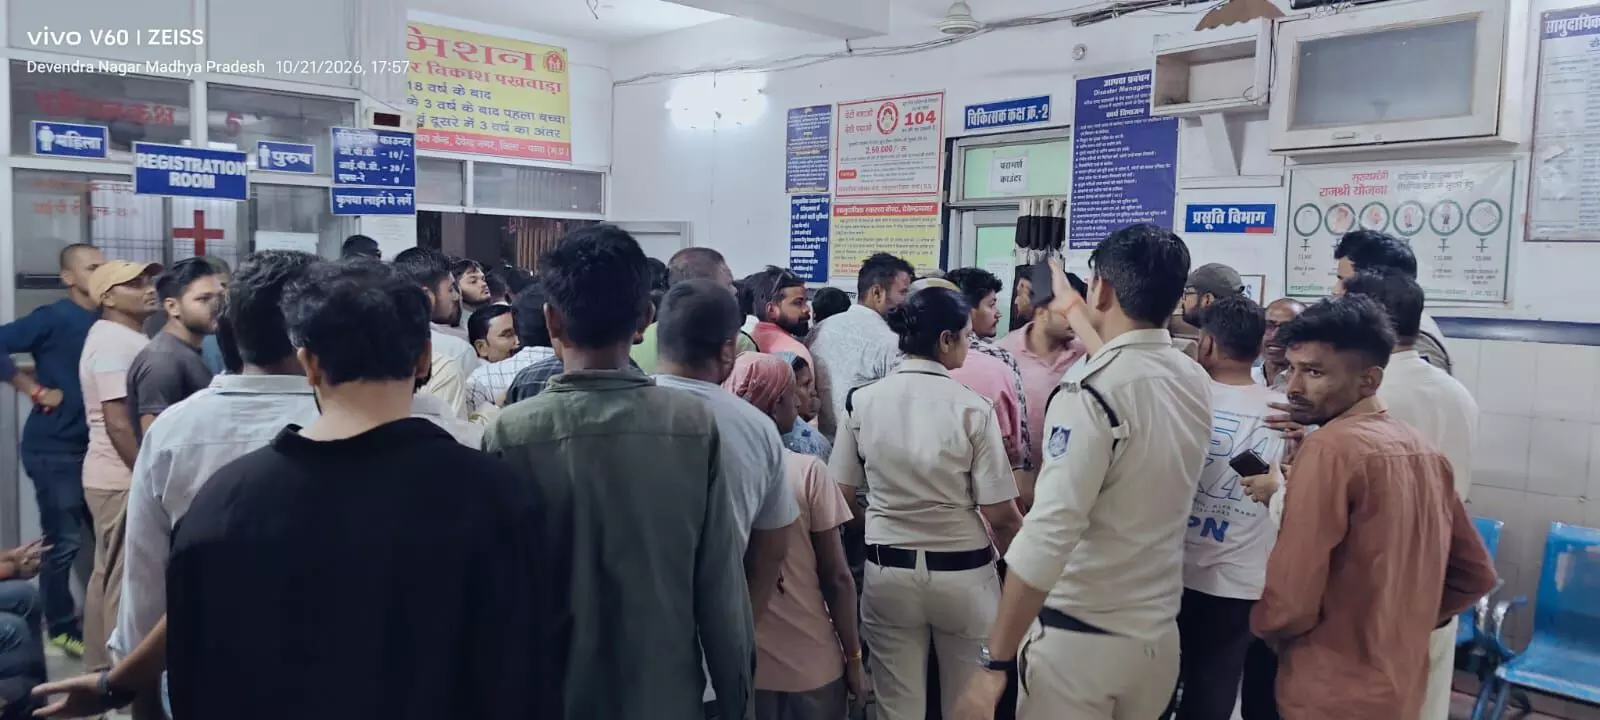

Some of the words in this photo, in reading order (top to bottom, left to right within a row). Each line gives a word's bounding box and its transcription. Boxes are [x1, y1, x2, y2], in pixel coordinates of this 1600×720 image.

[428, 80, 448, 95] वर्ष
[452, 82, 466, 96] के
[470, 86, 492, 100] बाद
[495, 73, 562, 95] पखवाड़ा
[1093, 88, 1117, 97] Disaster
[424, 99, 433, 109] 3
[437, 98, 457, 112] वर्ष
[461, 100, 474, 114] के
[479, 103, 500, 118] बाद
[503, 108, 535, 122] पहला
[538, 112, 568, 125] बच्चा
[904, 110, 937, 126] 104
[1008, 106, 1026, 123] कक्ष
[464, 115, 476, 129] में
[480, 120, 488, 130] 3
[492, 119, 510, 133] वर्ष
[514, 124, 531, 136] का
[534, 125, 561, 138] अंतर
[55, 130, 104, 151] महिला
[136, 152, 246, 176] REGISTRATION
[271, 150, 312, 168] पुरुष
[168, 171, 216, 190] ROOM
[1192, 207, 1226, 230] प्रसूति
[1228, 207, 1267, 224] विभाग
